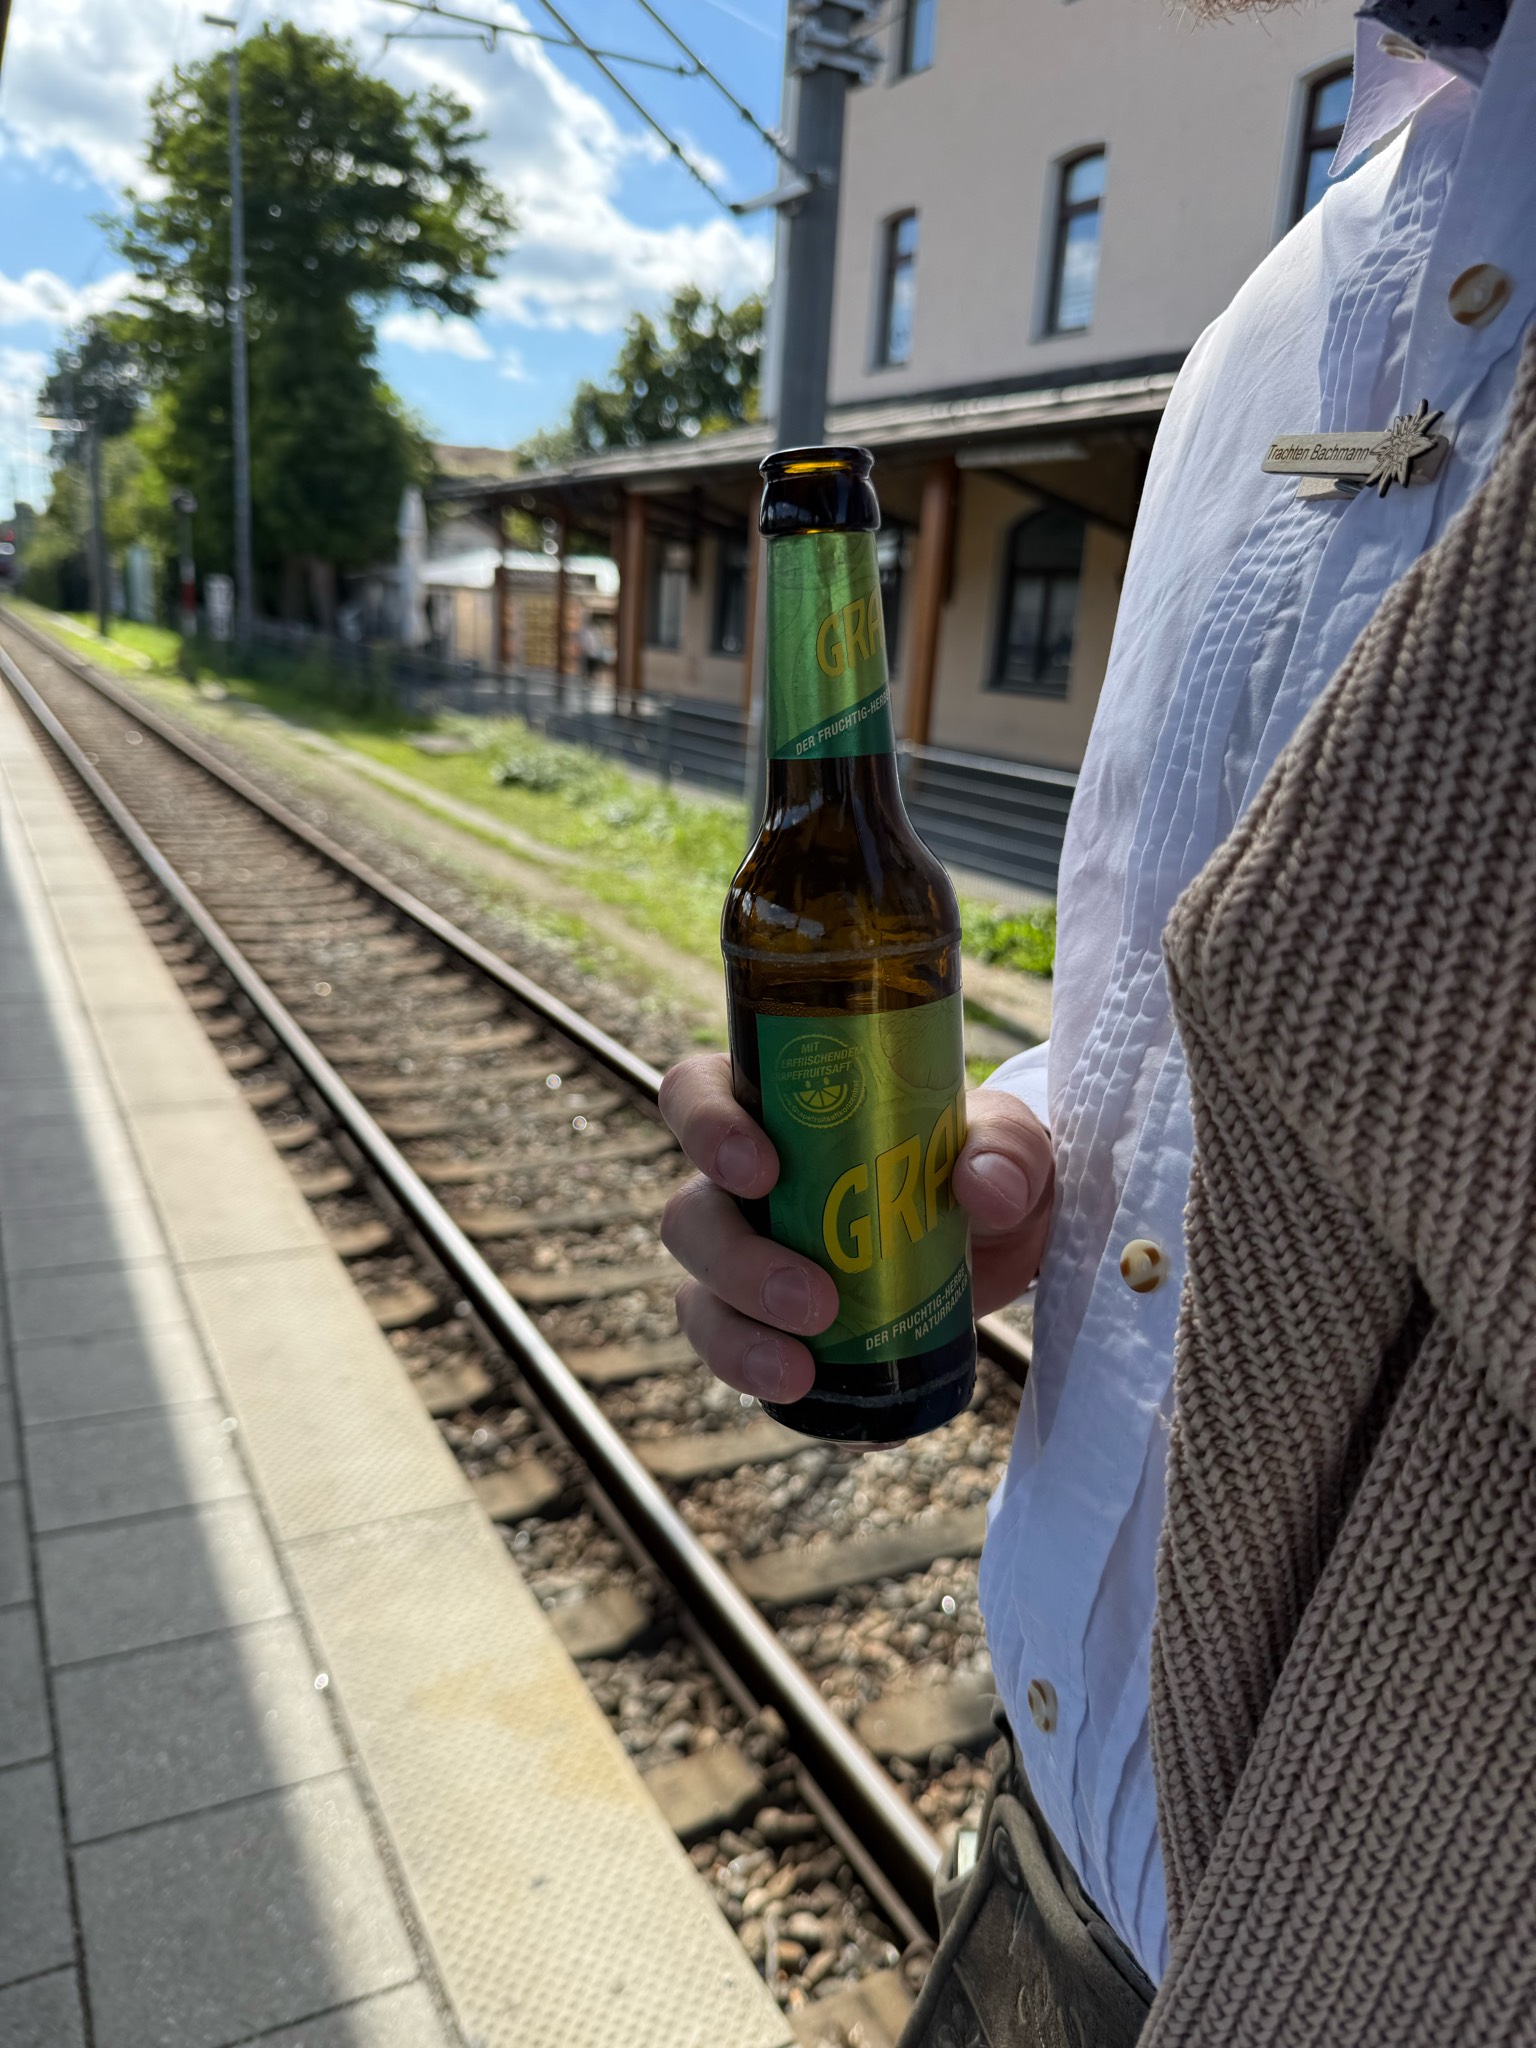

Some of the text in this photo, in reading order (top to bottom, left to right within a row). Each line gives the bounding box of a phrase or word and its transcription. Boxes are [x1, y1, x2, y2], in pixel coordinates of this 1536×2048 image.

[1267, 443, 1370, 461] Trachten Bachmann
[795, 735, 816, 757] DER
[781, 1045, 864, 1069] ERFRISCHENDEM
[800, 1041, 821, 1054] MIT
[770, 1060, 852, 1083] GRAPEFRUITSAFT
[865, 1263, 966, 1352] DER FRUCHTIG-HERBE
[914, 1273, 968, 1341] NATURRADLER
